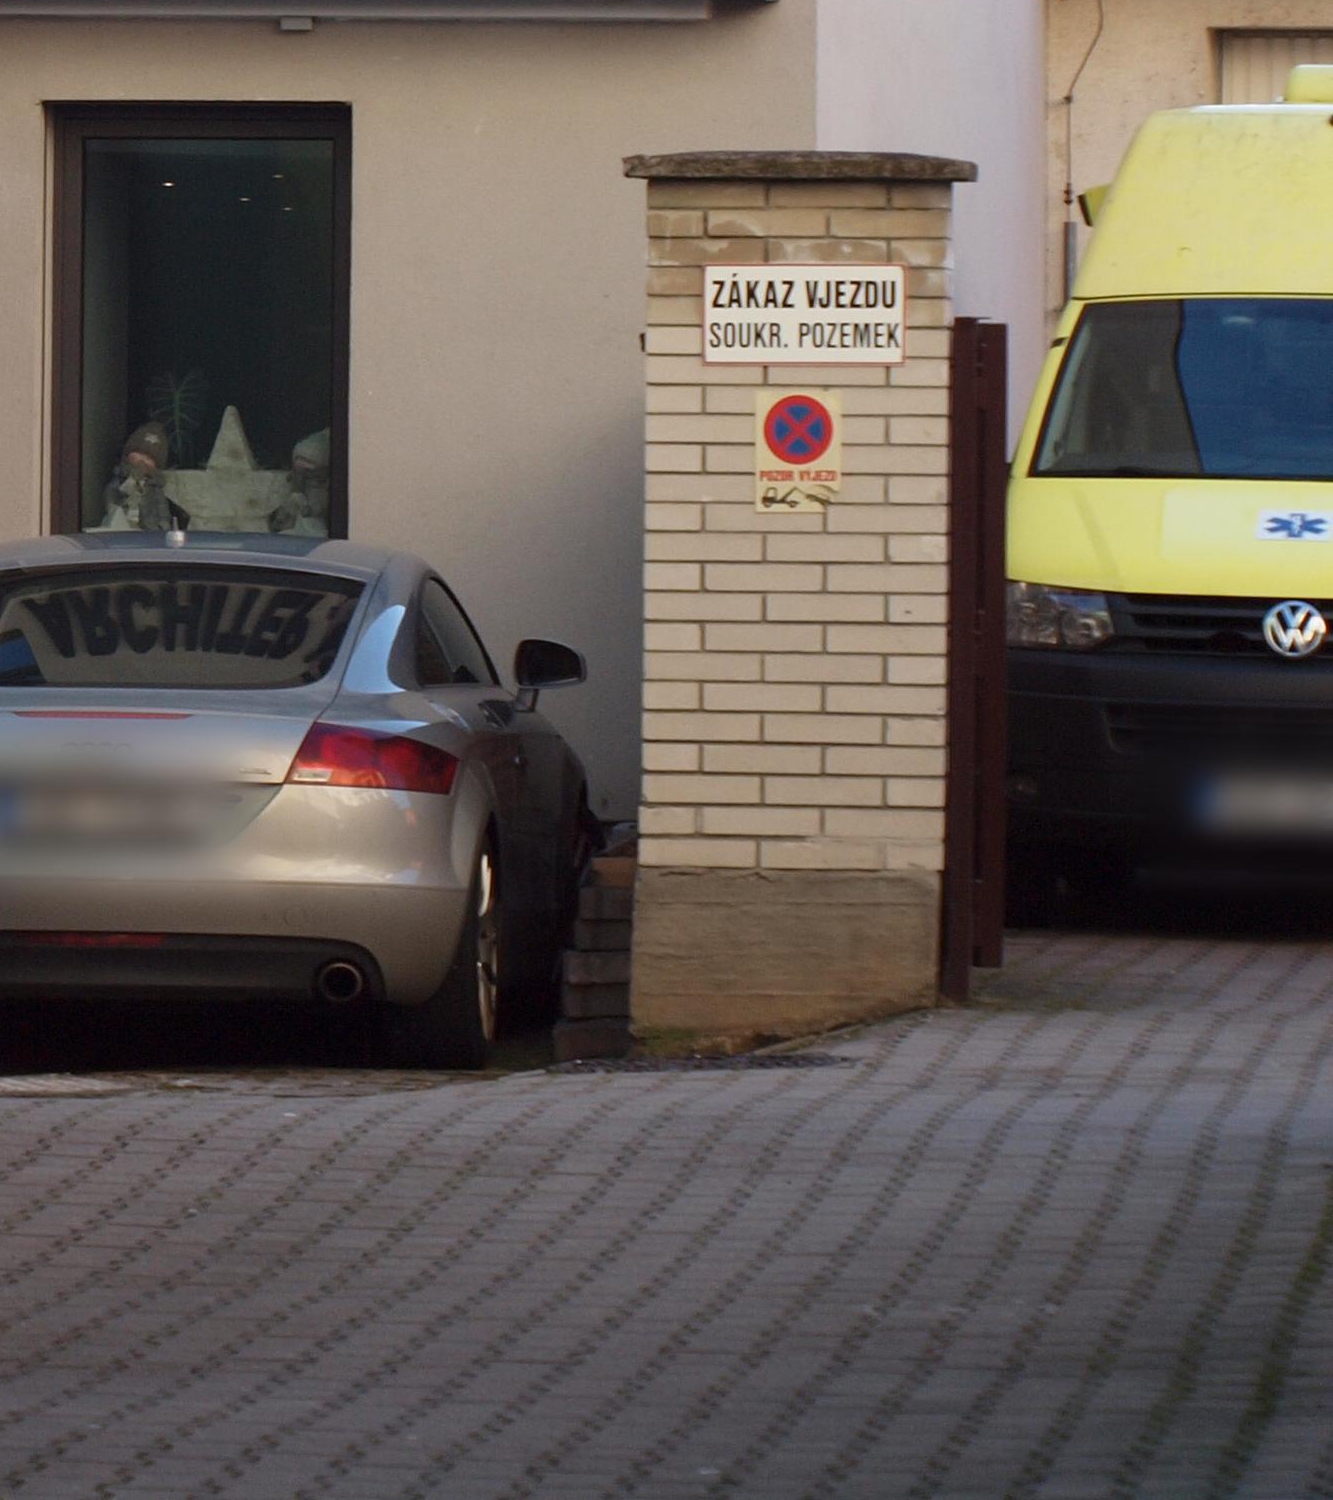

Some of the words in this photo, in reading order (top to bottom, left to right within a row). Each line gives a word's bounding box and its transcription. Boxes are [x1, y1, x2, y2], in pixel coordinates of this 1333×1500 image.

[712, 273, 795, 308] ZÁKAZ
[806, 280, 896, 308] VJEZDU
[709, 322, 789, 348] SOUKR.
[799, 323, 900, 348] POZEMEK
